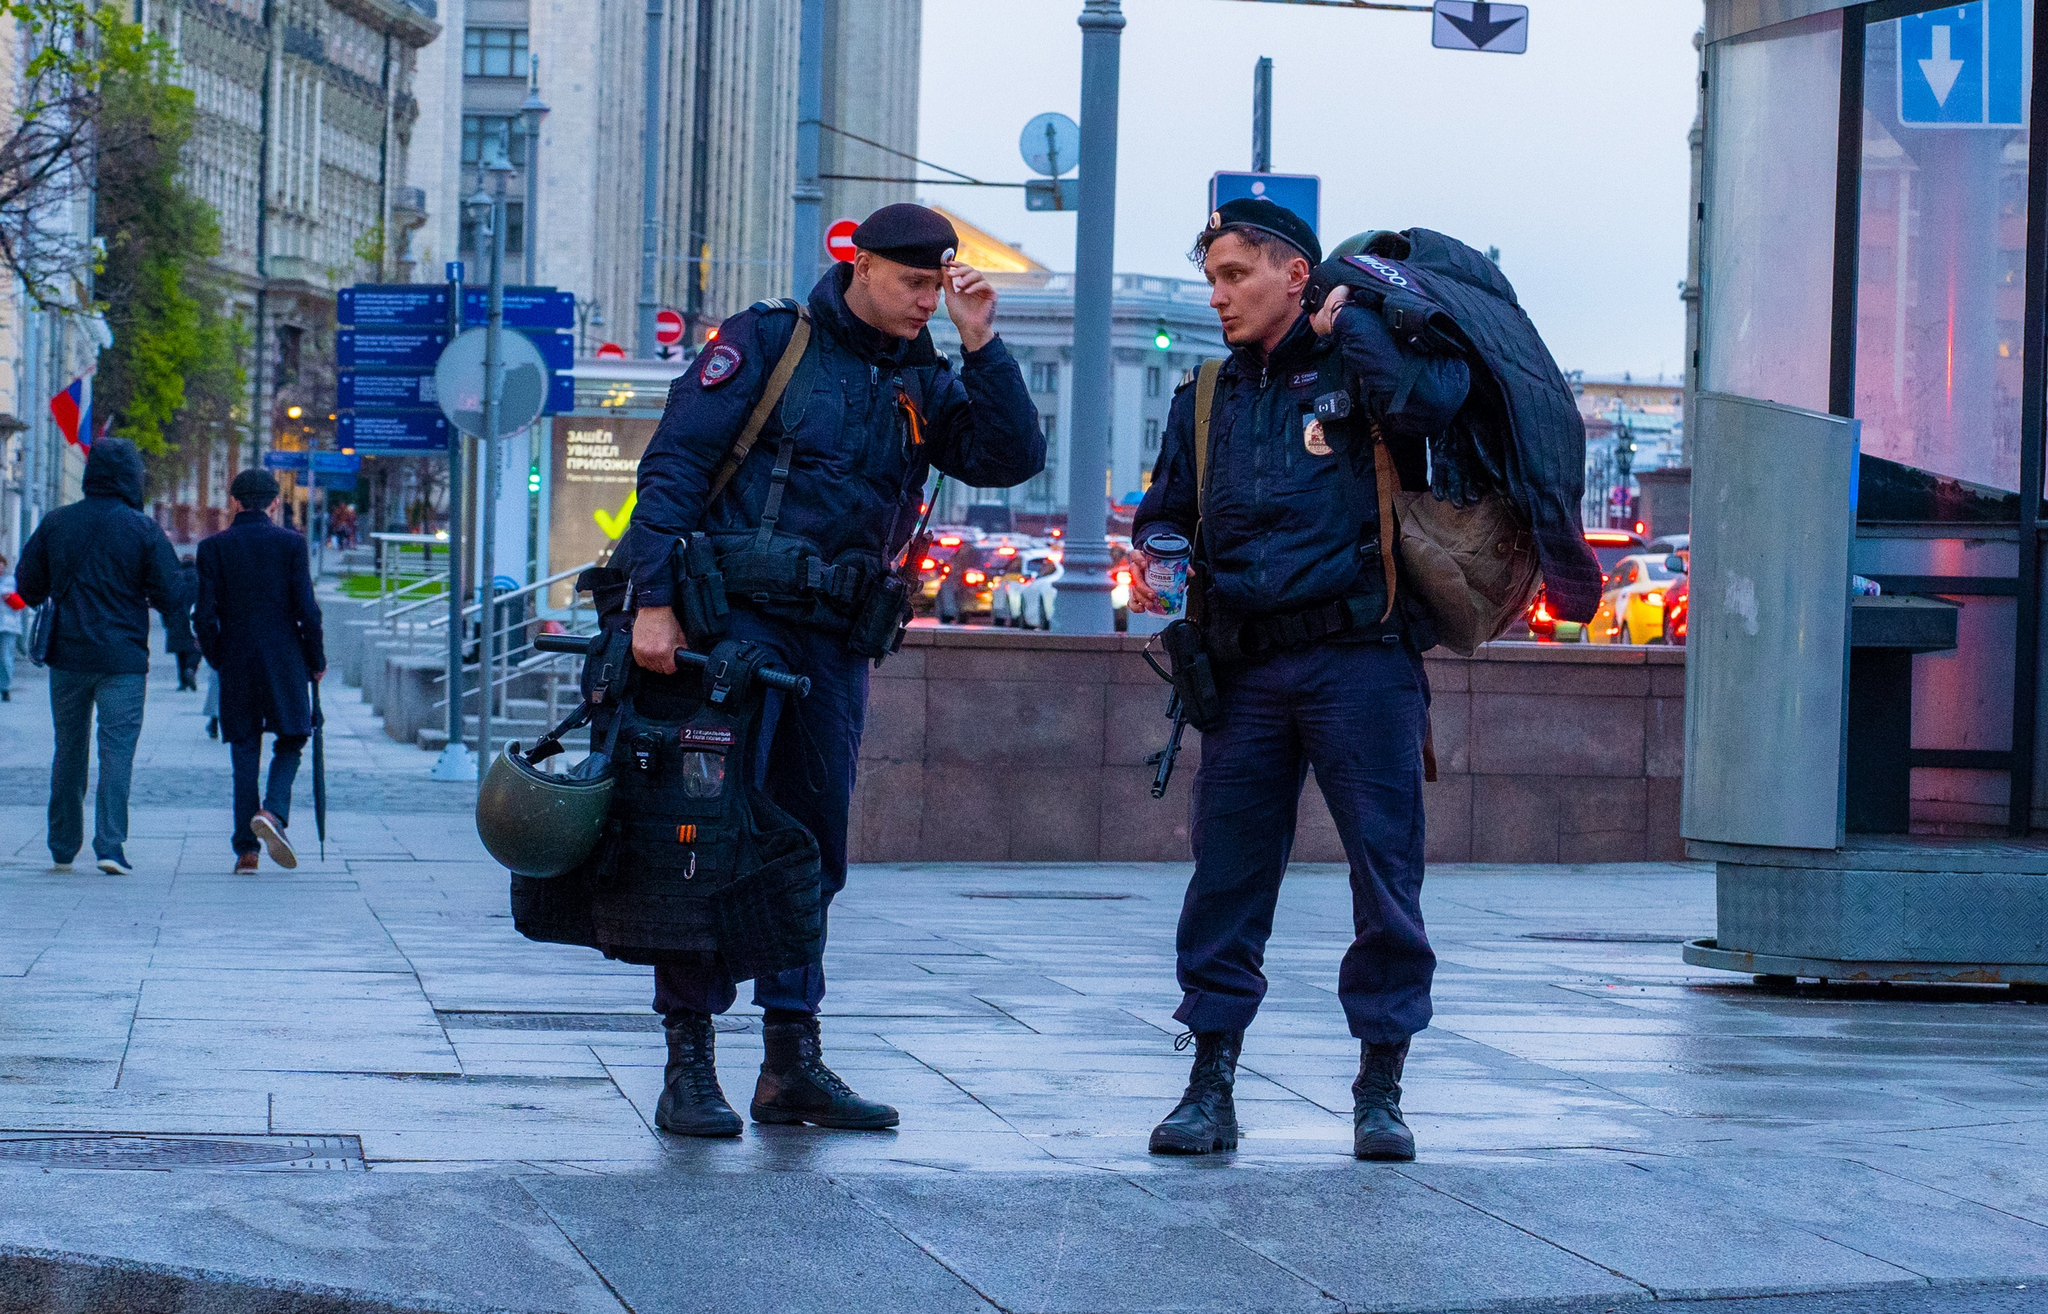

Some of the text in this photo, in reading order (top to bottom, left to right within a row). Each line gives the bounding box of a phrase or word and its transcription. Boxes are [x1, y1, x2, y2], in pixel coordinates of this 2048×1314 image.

[1293, 375, 1302, 384] 2
[567, 429, 613, 443] ЗАШЁЛ
[567, 444, 620, 458] УВИДЕЛ
[684, 729, 692, 739] 2
